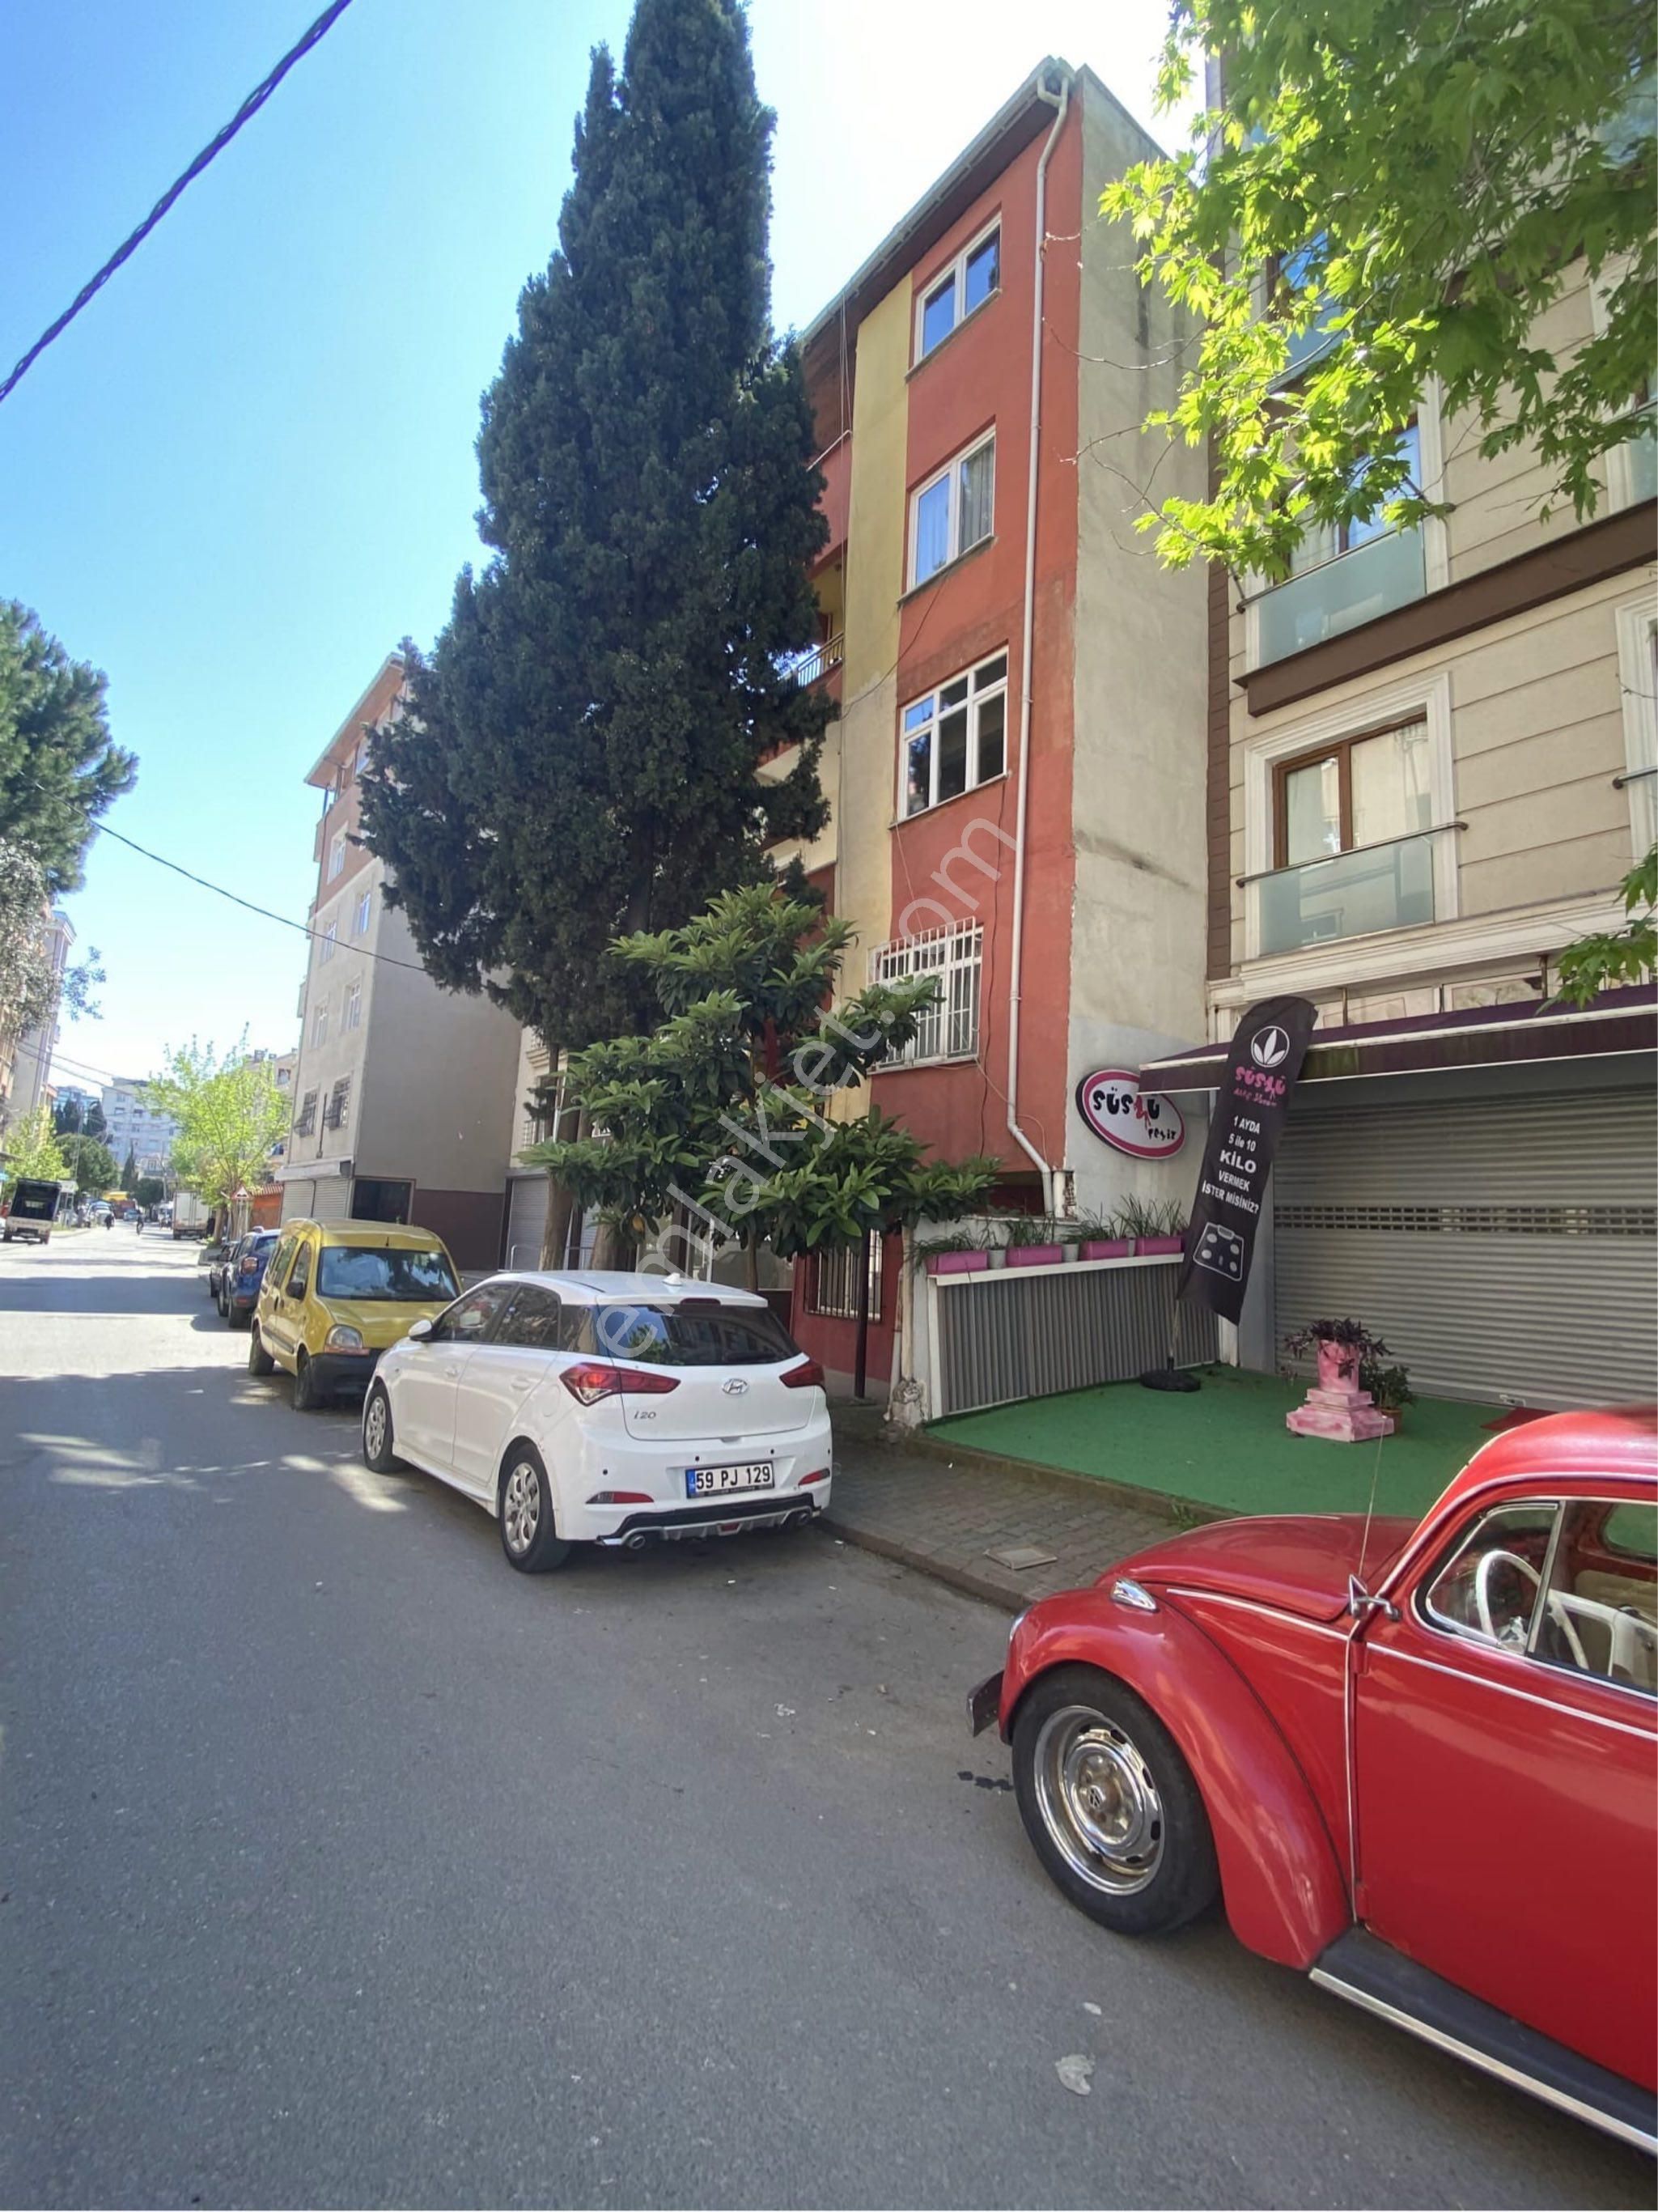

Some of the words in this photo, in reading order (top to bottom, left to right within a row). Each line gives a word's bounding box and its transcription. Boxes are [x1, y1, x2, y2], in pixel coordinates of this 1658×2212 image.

[1234, 1115, 1239, 1127] 1
[1239, 1118, 1261, 1134] AYDA
[1228, 1133, 1235, 1144] 5
[1235, 1135, 1245, 1148] ile
[1247, 1139, 1256, 1152] 10
[1219, 1149, 1257, 1173] KİLO
[1219, 1170, 1250, 1192] VERMEK
[1202, 1180, 1224, 1200] İSTER
[1225, 1191, 1259, 1214] MİSİNİZ?
[697, 1471, 714, 1489] 59
[721, 1469, 738, 1487] PJ
[746, 1466, 770, 1484] 129
